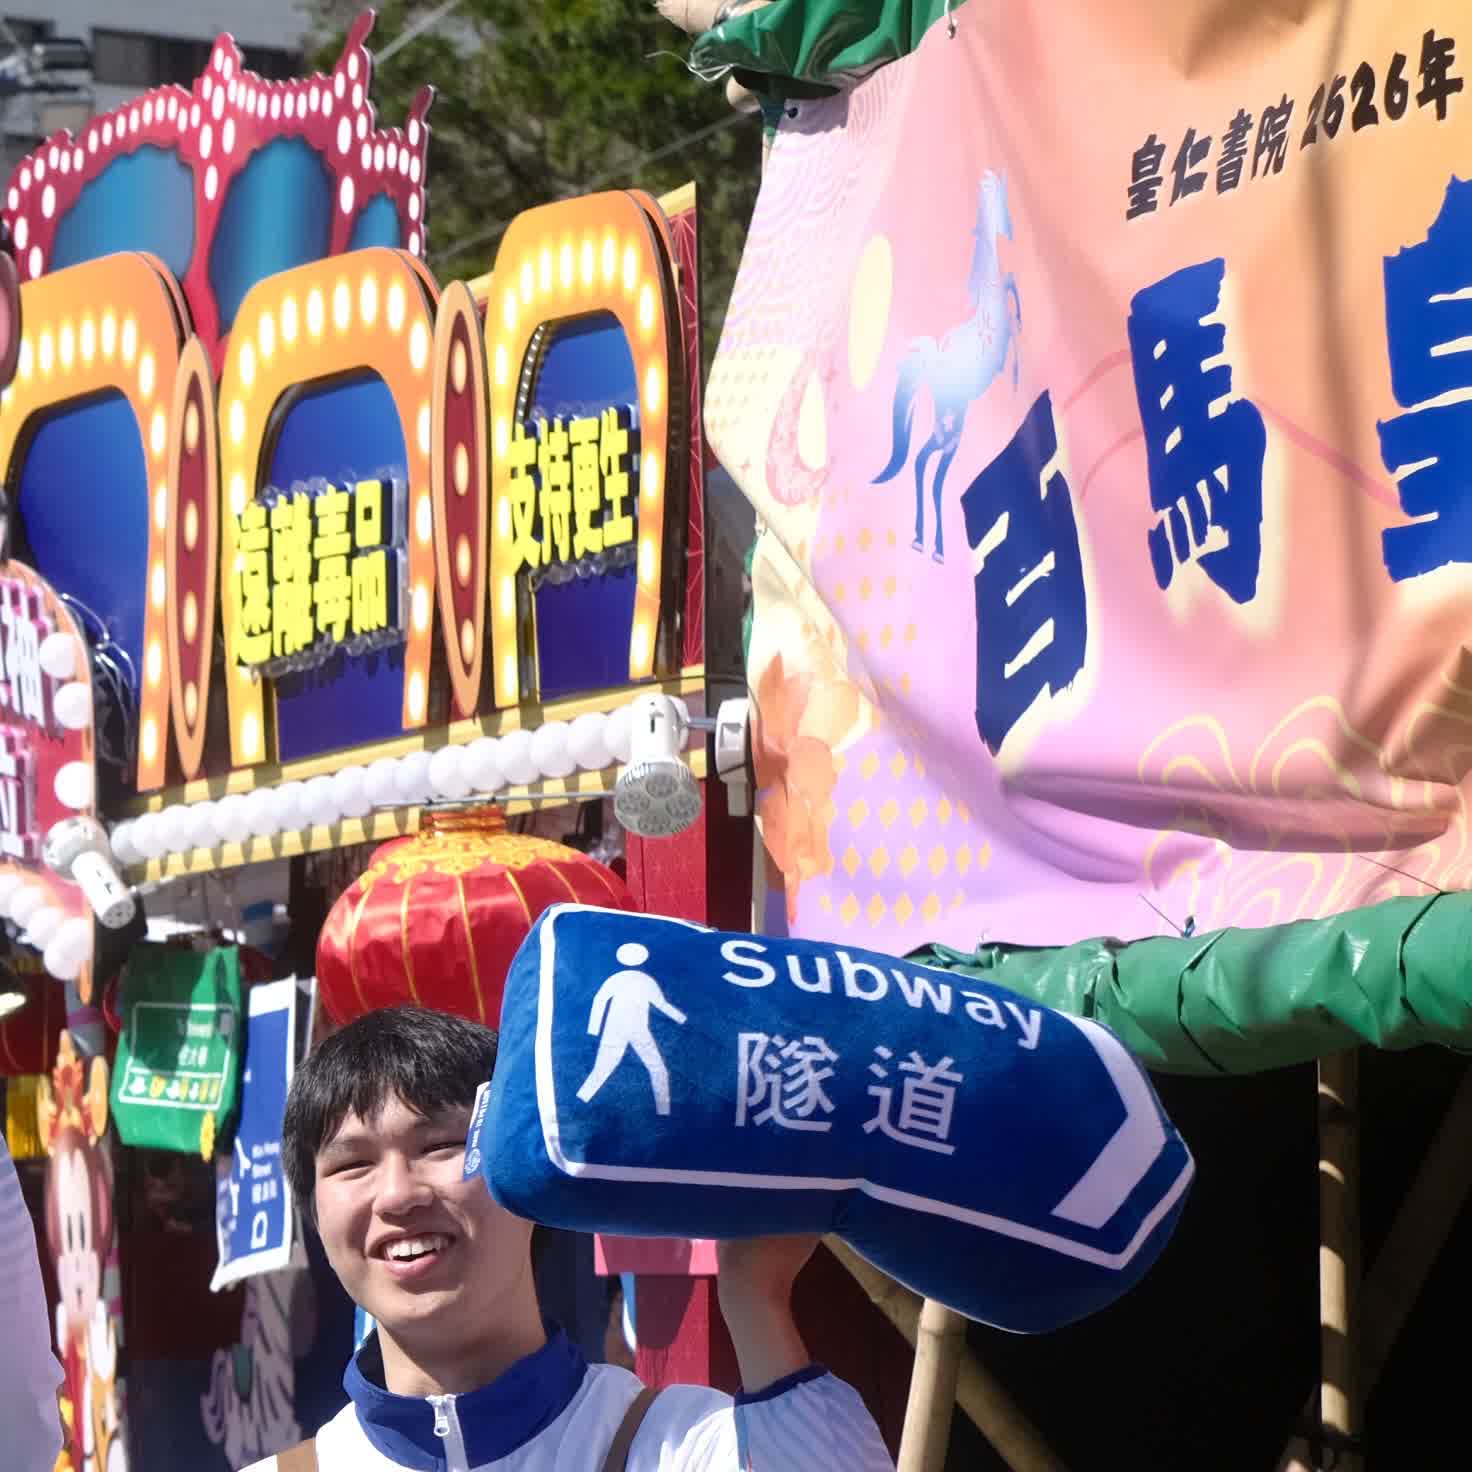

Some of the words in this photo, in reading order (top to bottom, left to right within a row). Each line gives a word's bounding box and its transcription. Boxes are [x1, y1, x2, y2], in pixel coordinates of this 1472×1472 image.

[1125, 93, 1295, 222] 皇仁書院
[508, 406, 635, 577] 支持更生
[236, 478, 389, 665] 遠離毒品
[720, 939, 1044, 1050] Subway
[734, 1031, 965, 1156] 隧道
